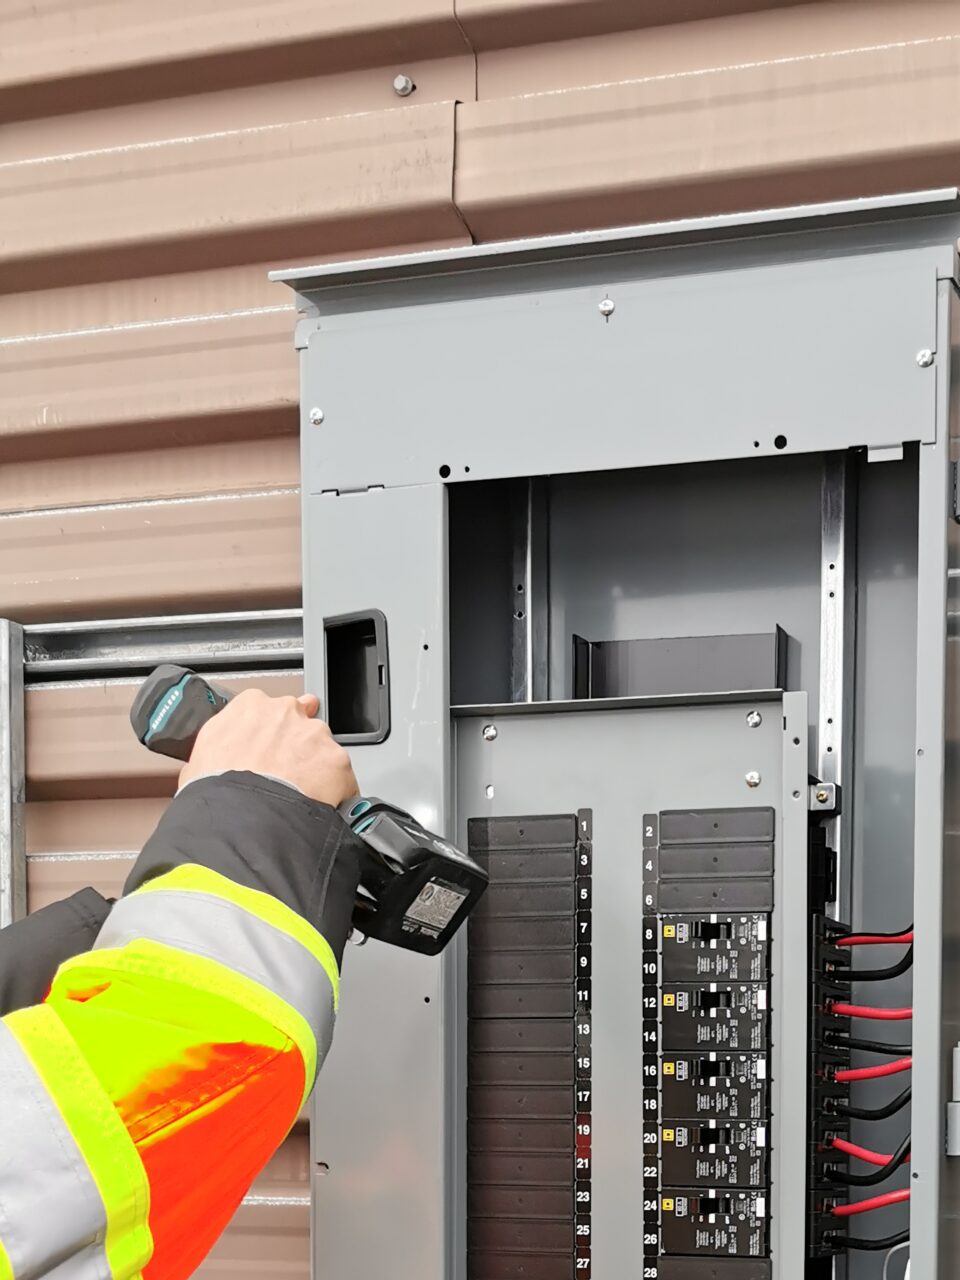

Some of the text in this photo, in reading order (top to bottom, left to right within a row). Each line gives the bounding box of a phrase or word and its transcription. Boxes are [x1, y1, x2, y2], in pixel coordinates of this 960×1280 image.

[580, 820, 588, 832] 1
[645, 826, 653, 838] 2
[580, 854, 588, 866] 3
[645, 860, 653, 872] 4
[580, 888, 588, 900] 5
[645, 894, 653, 906] 6
[580, 922, 588, 934] 7
[645, 928, 653, 940] 8
[580, 956, 588, 968] 9
[643, 963, 657, 975] 10
[577, 990, 588, 1002] 11
[643, 997, 657, 1009] 12
[577, 1023, 589, 1035] 13
[643, 1031, 657, 1043] 14
[577, 1057, 589, 1069] 15
[643, 1065, 657, 1077] 16
[577, 1091, 589, 1103] 17
[643, 1099, 657, 1111] 18
[577, 1124, 589, 1136] 19
[643, 1132, 657, 1144] 20
[577, 1157, 589, 1169] 21
[643, 1166, 657, 1178] 22
[577, 1191, 589, 1203] 23
[643, 1200, 657, 1212] 24
[577, 1224, 589, 1236] 25
[643, 1233, 657, 1245] 26
[577, 1258, 589, 1270] 27
[643, 1267, 657, 1279] 28
